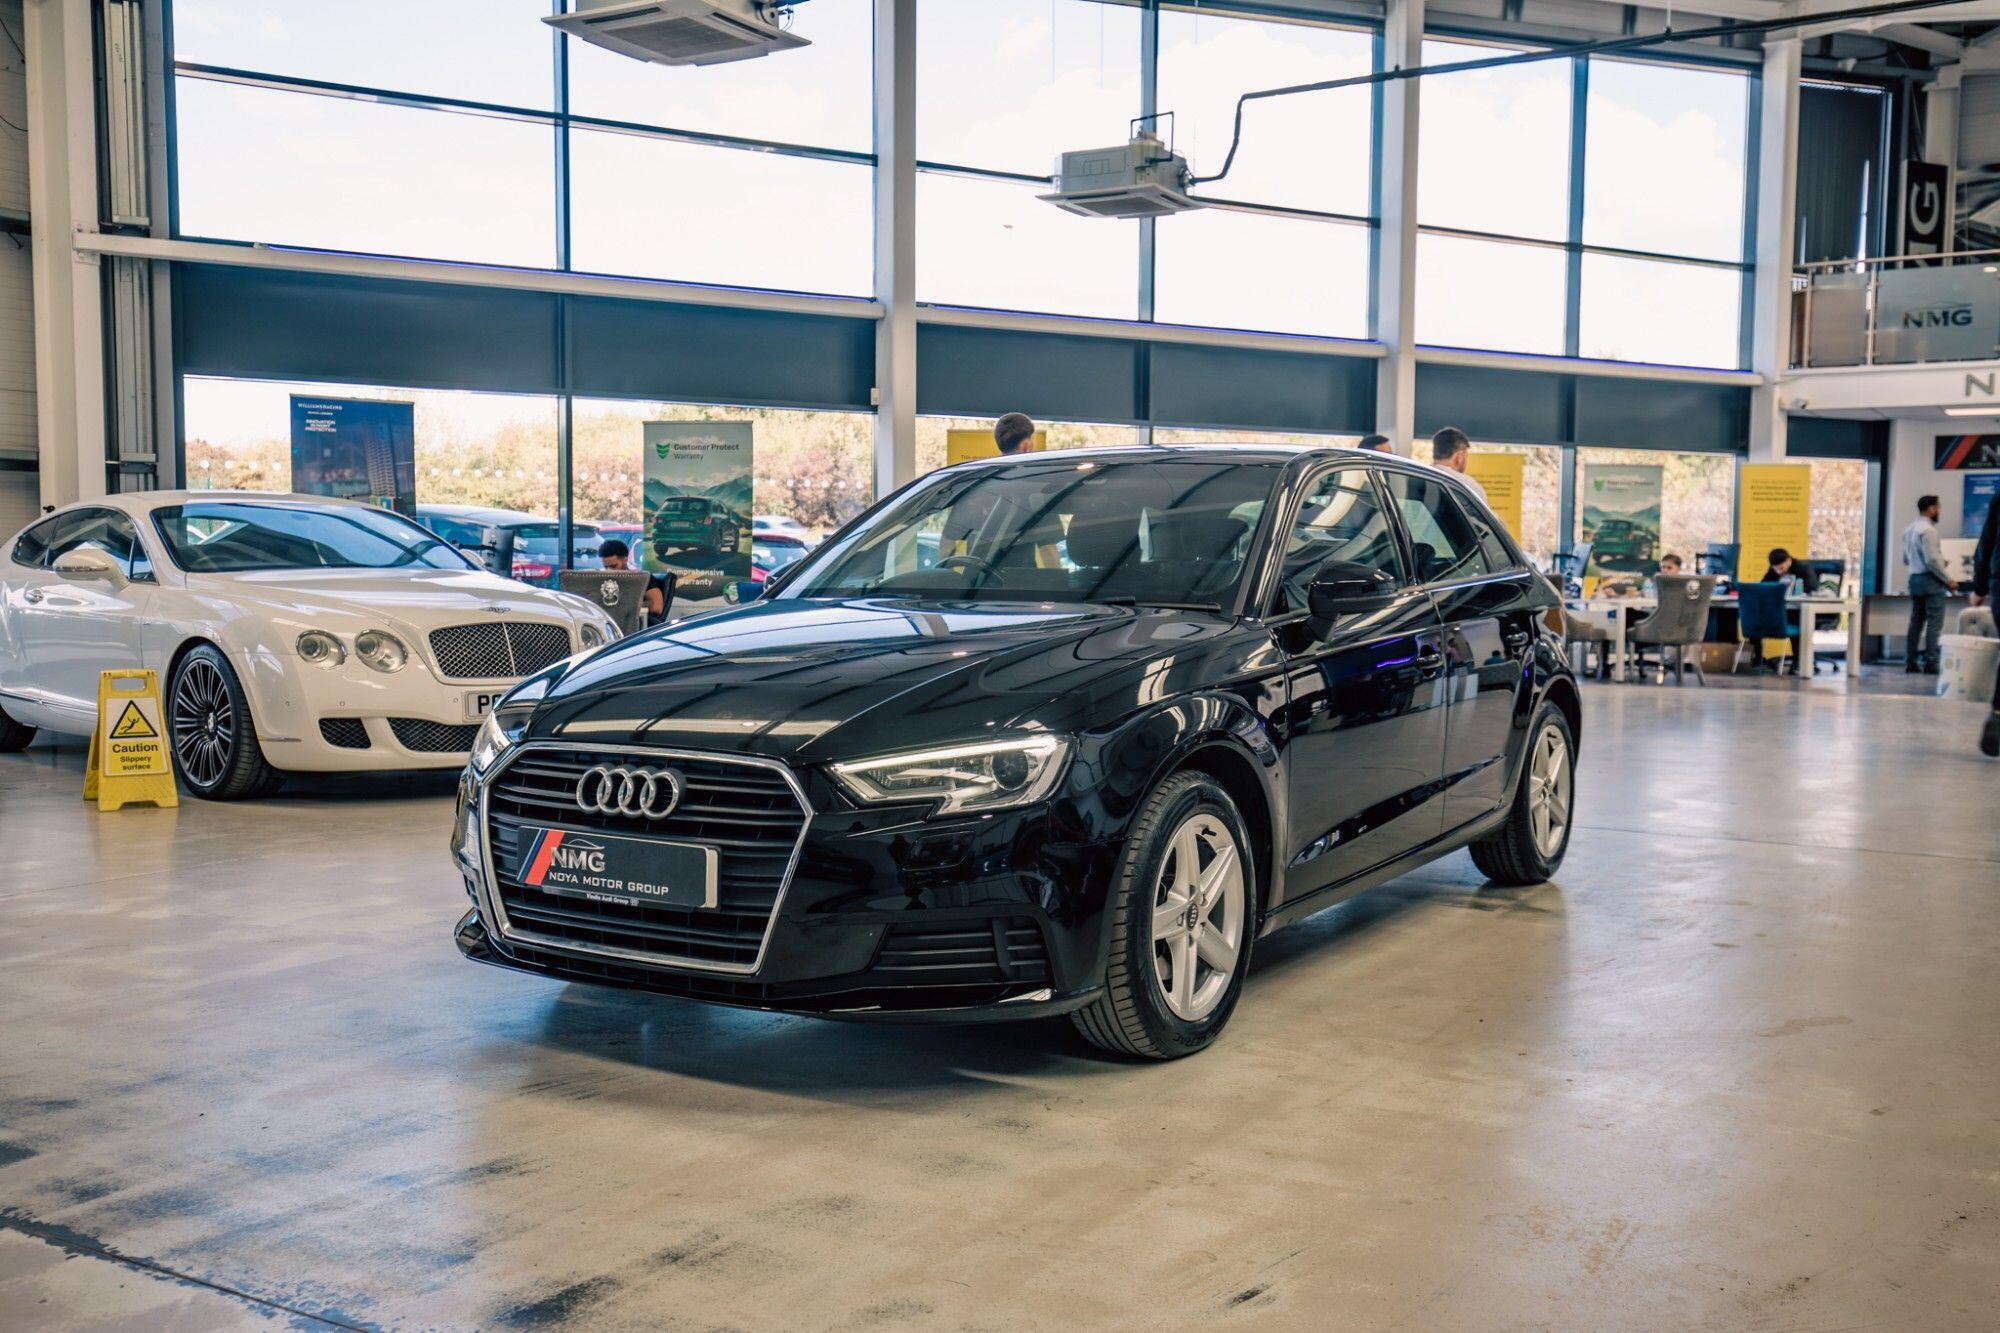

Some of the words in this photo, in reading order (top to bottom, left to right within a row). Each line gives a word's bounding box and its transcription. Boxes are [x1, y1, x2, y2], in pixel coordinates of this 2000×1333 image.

[1903, 308, 1973, 329] NMG
[1965, 373, 1995, 397] N
[673, 443, 710, 451] Customer
[711, 443, 739, 451] Protect
[673, 453, 704, 461] Warranty
[666, 567, 724, 578] Comprehensive
[112, 742, 158, 754] Caution
[120, 755, 152, 764] Slippery
[122, 763, 151, 771] surface
[549, 846, 606, 873] NMG
[548, 871, 579, 884] NOYA
[582, 875, 623, 890] MOTOR
[627, 881, 669, 896] GROUP
[613, 896, 629, 905] Group
